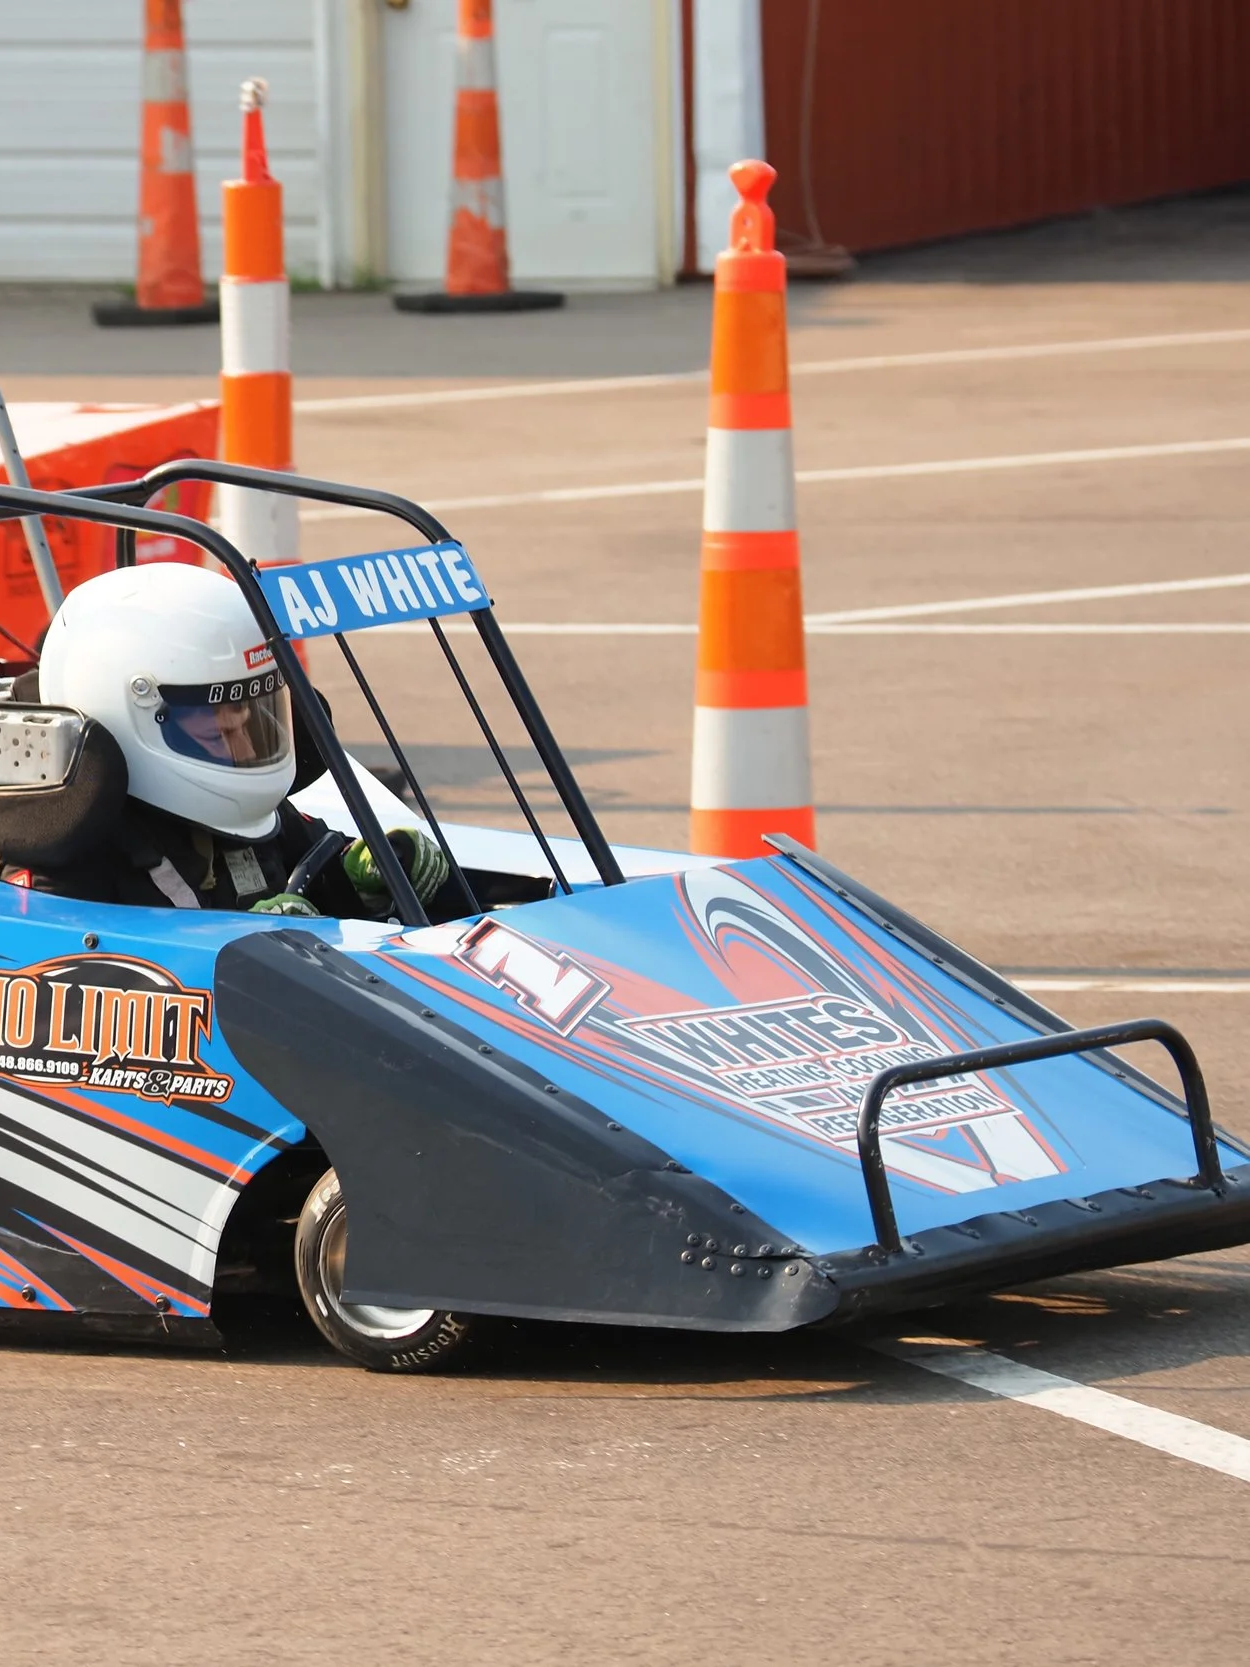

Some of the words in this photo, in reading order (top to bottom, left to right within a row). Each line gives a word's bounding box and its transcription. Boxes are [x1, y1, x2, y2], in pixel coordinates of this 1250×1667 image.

[278, 570, 338, 635] AJ
[337, 550, 482, 617] WHITE
[43, 981, 204, 1065] LIMIT
[644, 1001, 904, 1068] WHITES
[810, 1091, 997, 1135] REFIGERATION
